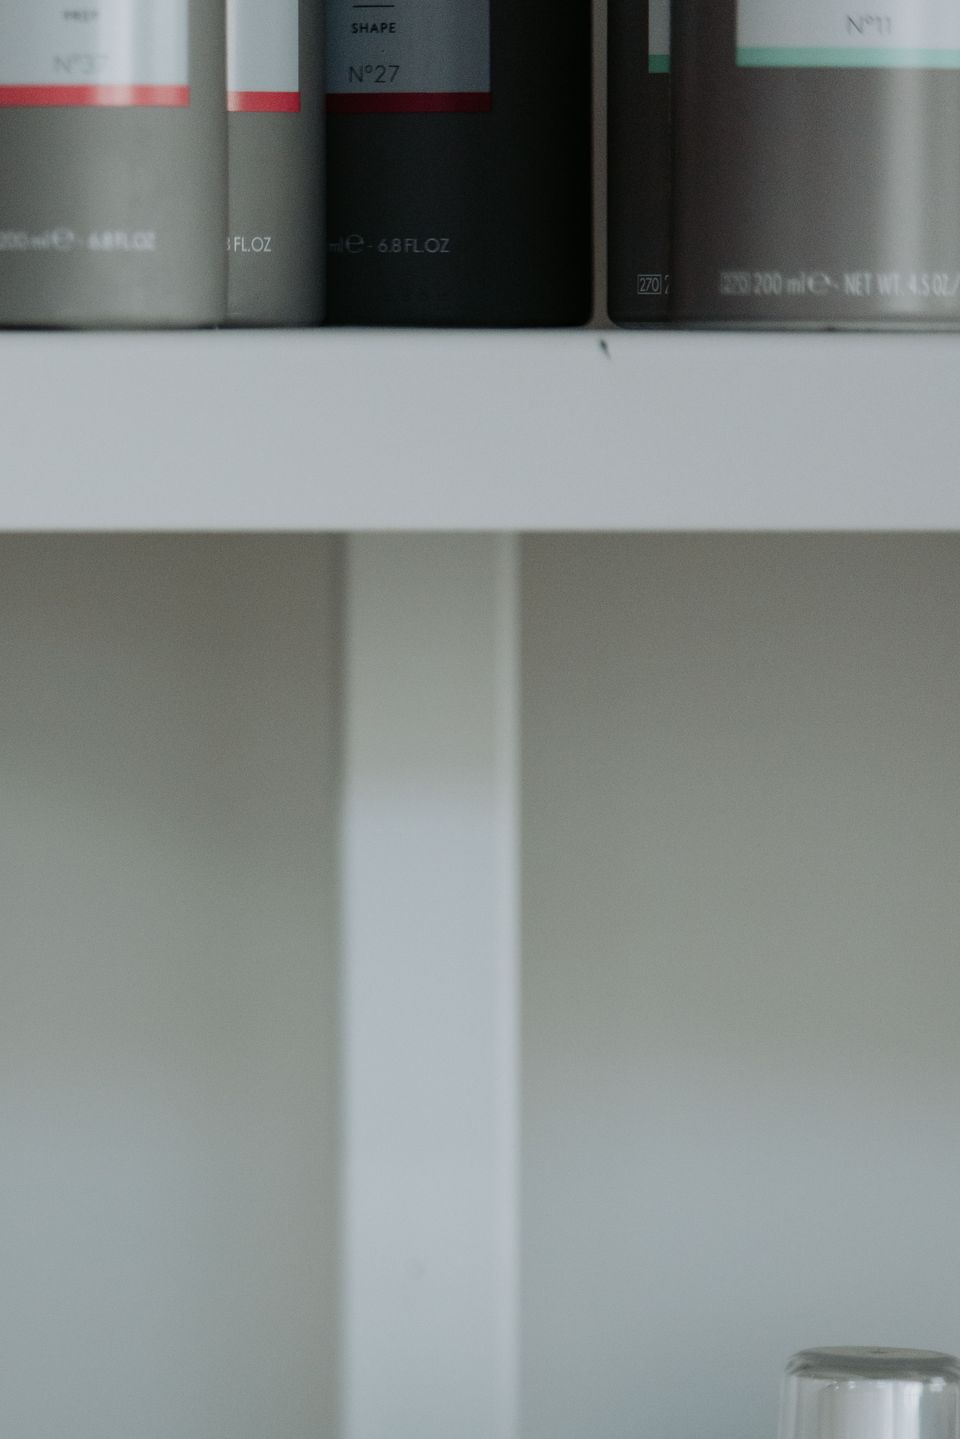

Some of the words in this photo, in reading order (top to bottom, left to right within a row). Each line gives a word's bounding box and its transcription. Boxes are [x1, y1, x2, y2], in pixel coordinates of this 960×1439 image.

[351, 22, 396, 33] SHAPE
[640, 277, 659, 292] 270
[845, 273, 870, 295] NET
